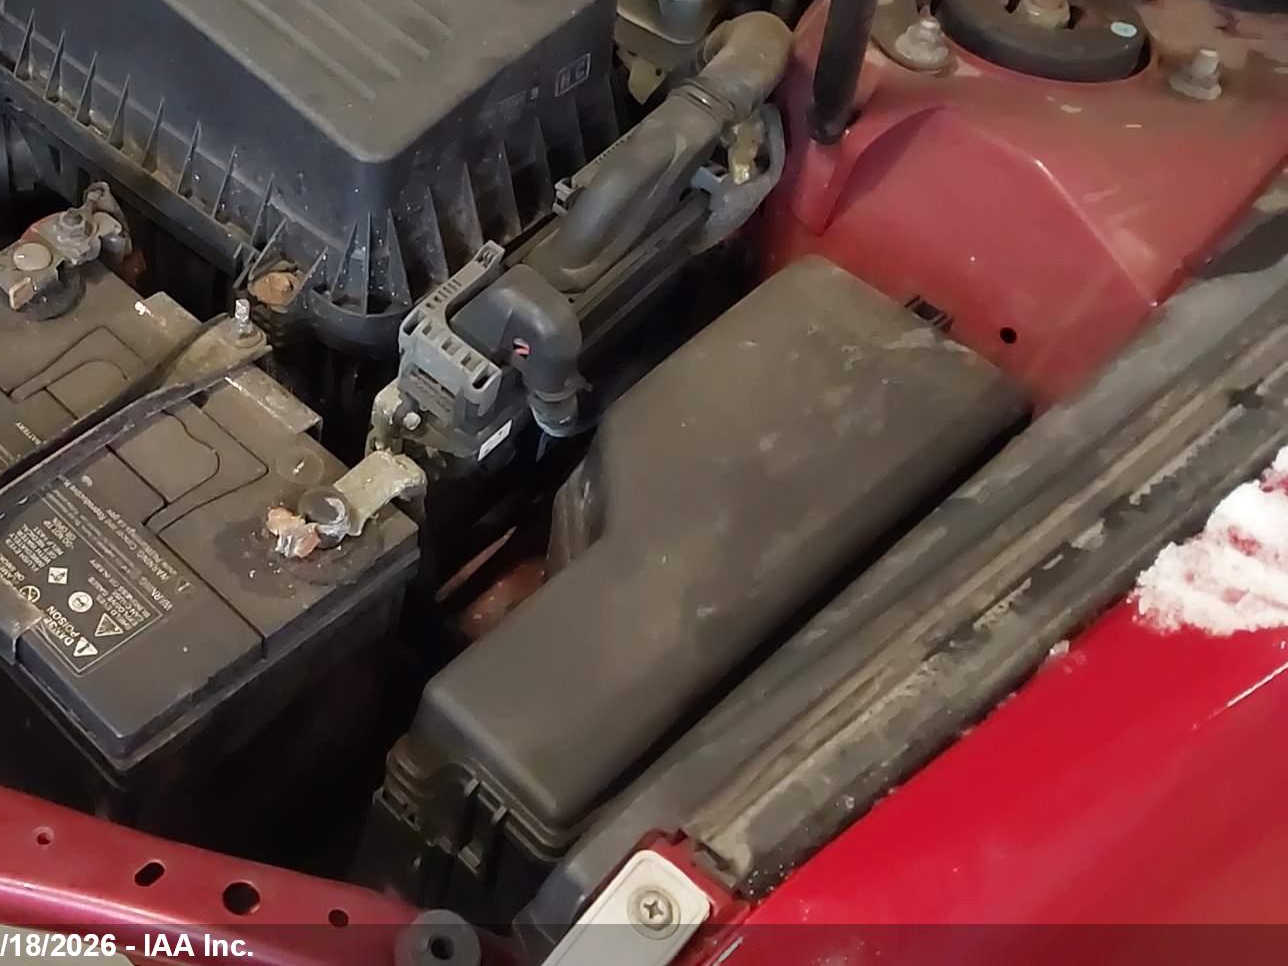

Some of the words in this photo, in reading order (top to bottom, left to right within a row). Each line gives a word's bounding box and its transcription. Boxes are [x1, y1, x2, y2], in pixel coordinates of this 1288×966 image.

[68, 483, 108, 521] Reproductive
[8, 531, 45, 567] IMMEDIATELY
[20, 523, 46, 547] MEDICAL
[18, 552, 39, 572] FLUSH
[106, 595, 138, 626] EXPLOSIVE
[116, 585, 150, 617] BLINDNESS
[45, 604, 81, 638] POISON
